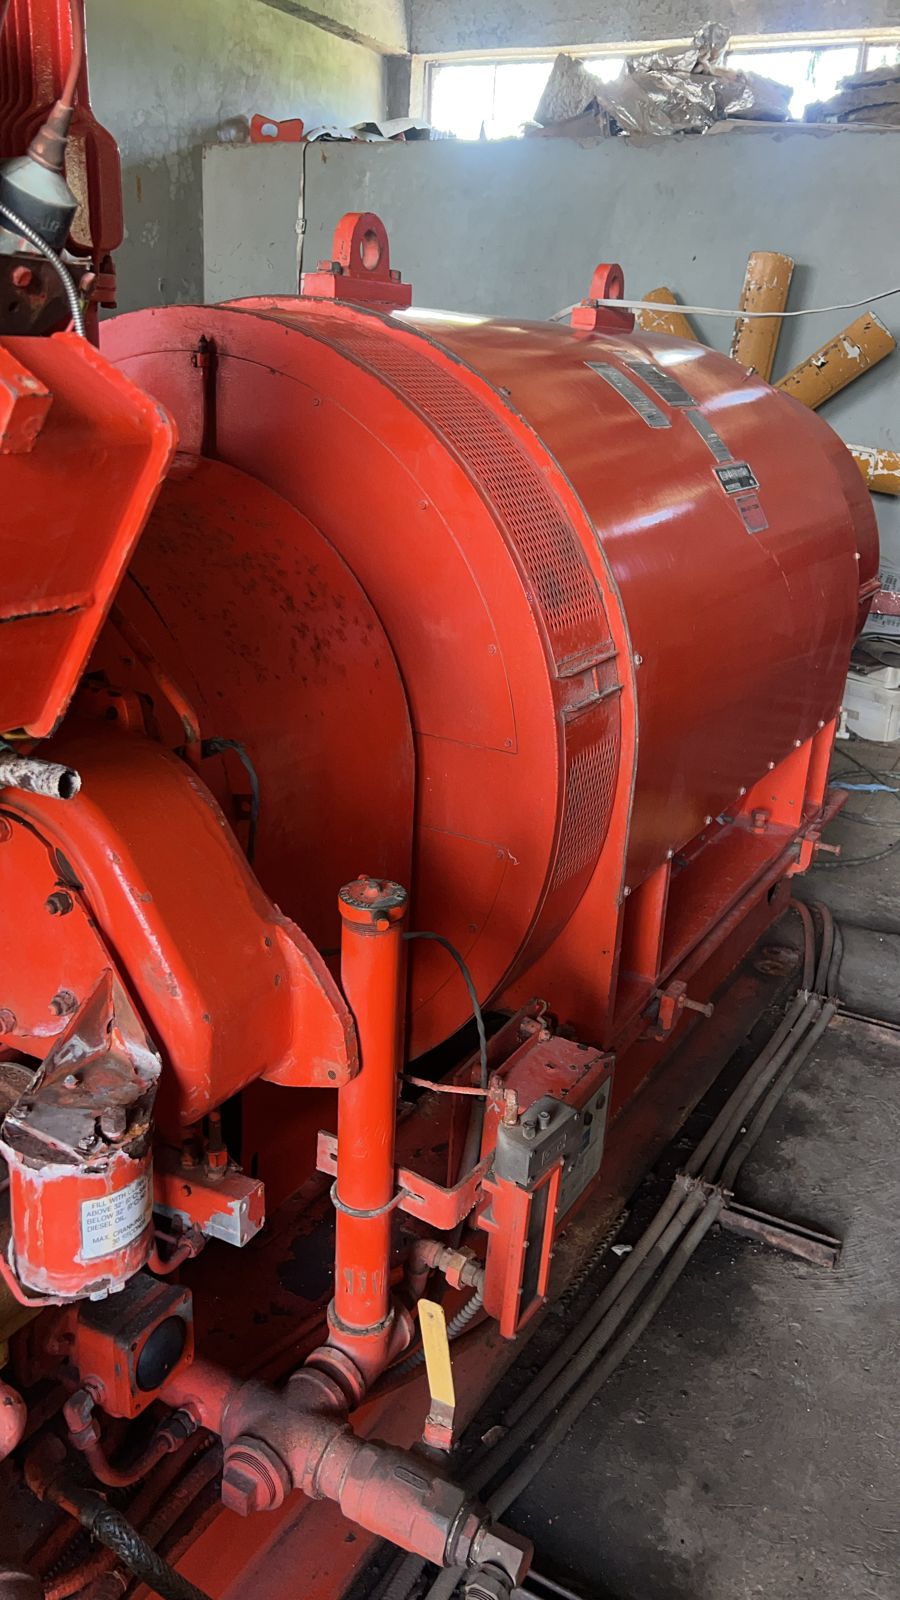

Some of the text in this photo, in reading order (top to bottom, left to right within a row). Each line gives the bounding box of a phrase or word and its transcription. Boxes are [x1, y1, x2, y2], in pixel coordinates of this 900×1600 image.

[109, 1193, 126, 1203] WITH
[86, 1207, 110, 1216] ABOVE
[87, 1213, 113, 1224] BELOW
[87, 1221, 112, 1232] DIESEL
